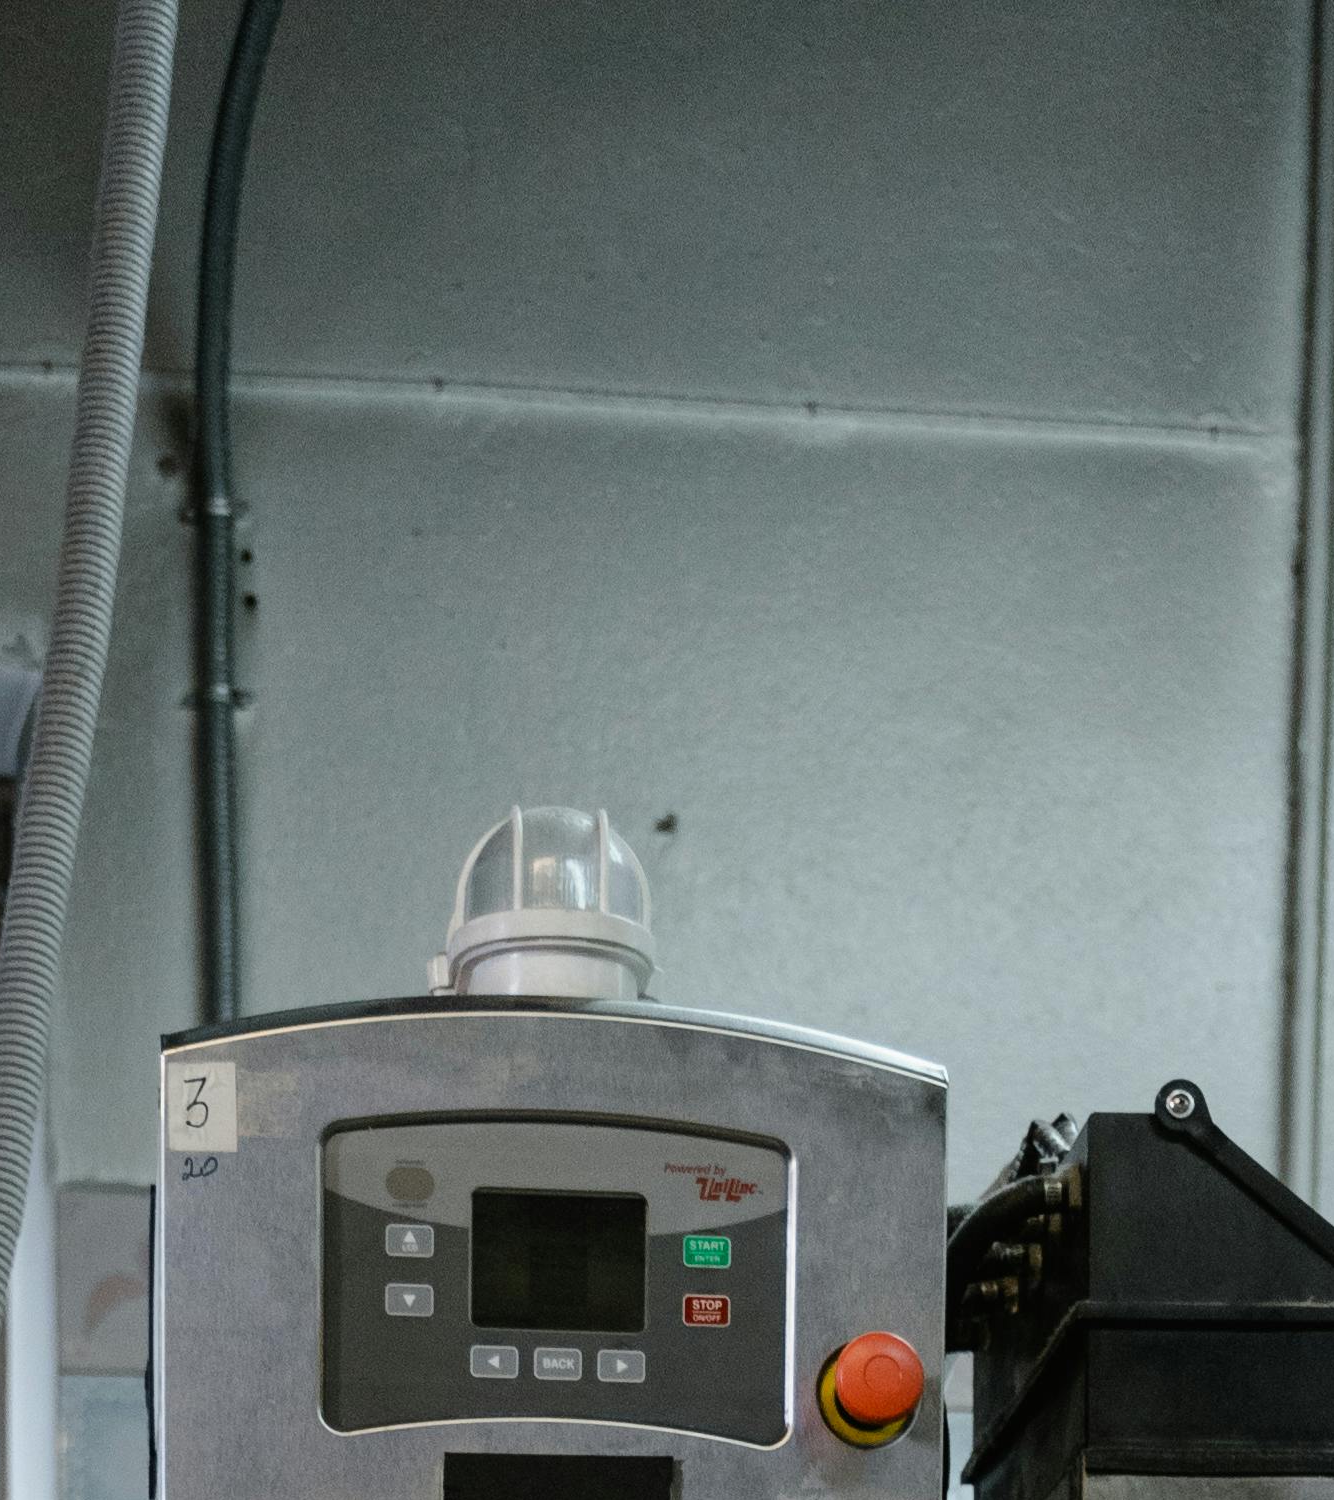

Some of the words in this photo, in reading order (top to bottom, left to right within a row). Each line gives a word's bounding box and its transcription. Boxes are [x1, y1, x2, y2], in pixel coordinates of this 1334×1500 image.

[183, 1076, 209, 1129] 3
[181, 1156, 219, 1181] 20
[664, 1162, 711, 1175] Powered
[713, 1164, 727, 1178] by
[689, 1240, 725, 1251] START
[692, 1299, 723, 1311] STOP
[542, 1357, 575, 1370] BACK
